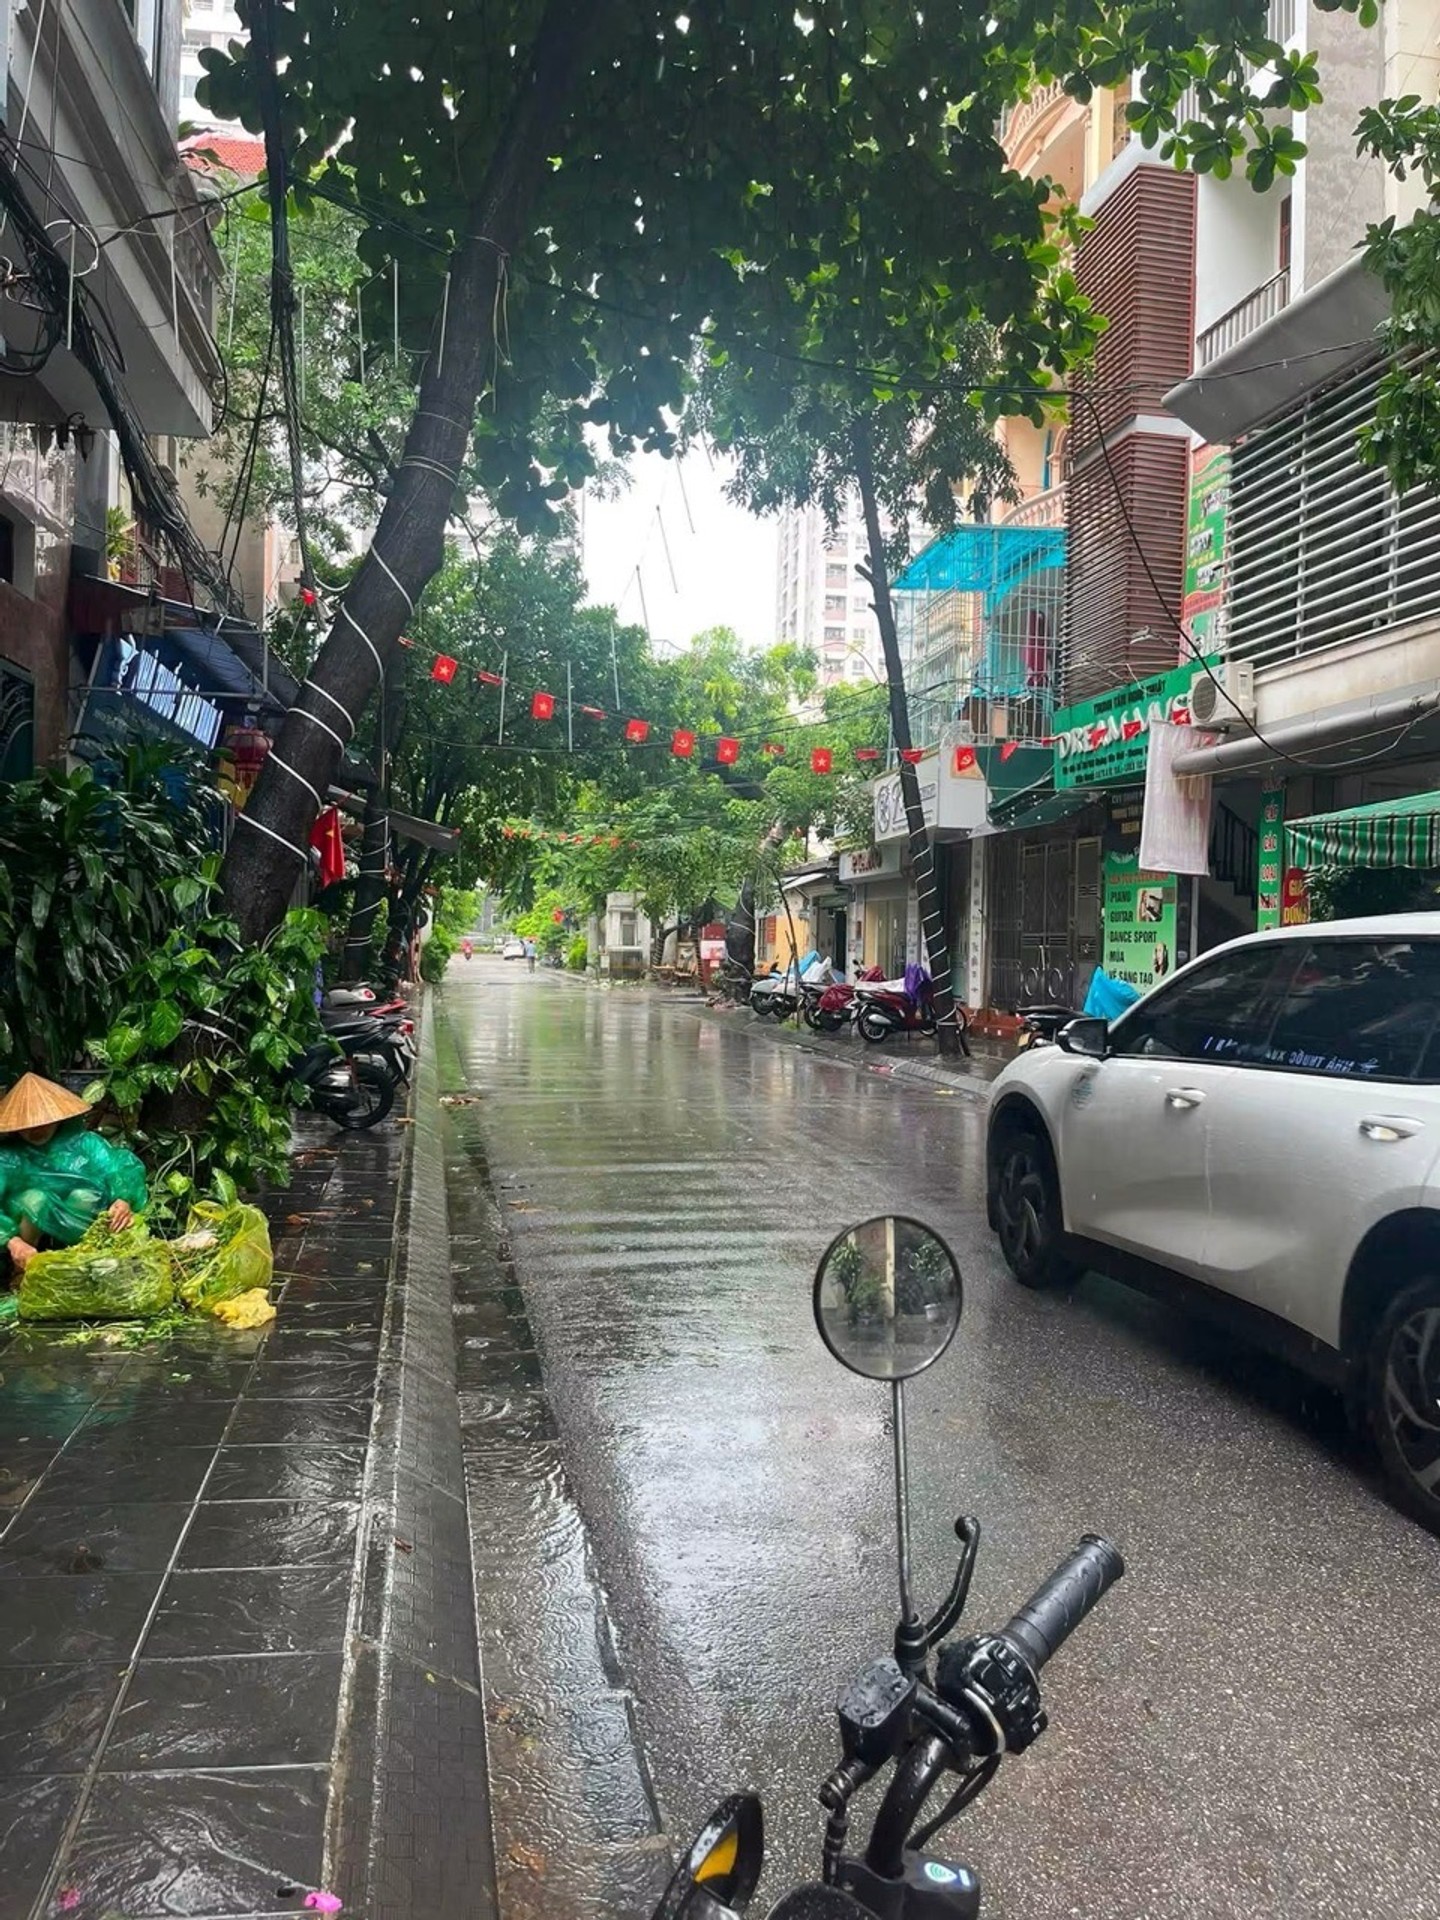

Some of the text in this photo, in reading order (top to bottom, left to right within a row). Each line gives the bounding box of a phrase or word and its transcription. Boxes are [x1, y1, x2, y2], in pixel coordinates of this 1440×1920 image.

[1110, 911, 1133, 922] GUITAR
[1109, 931, 1157, 943] DANCE SPORT
